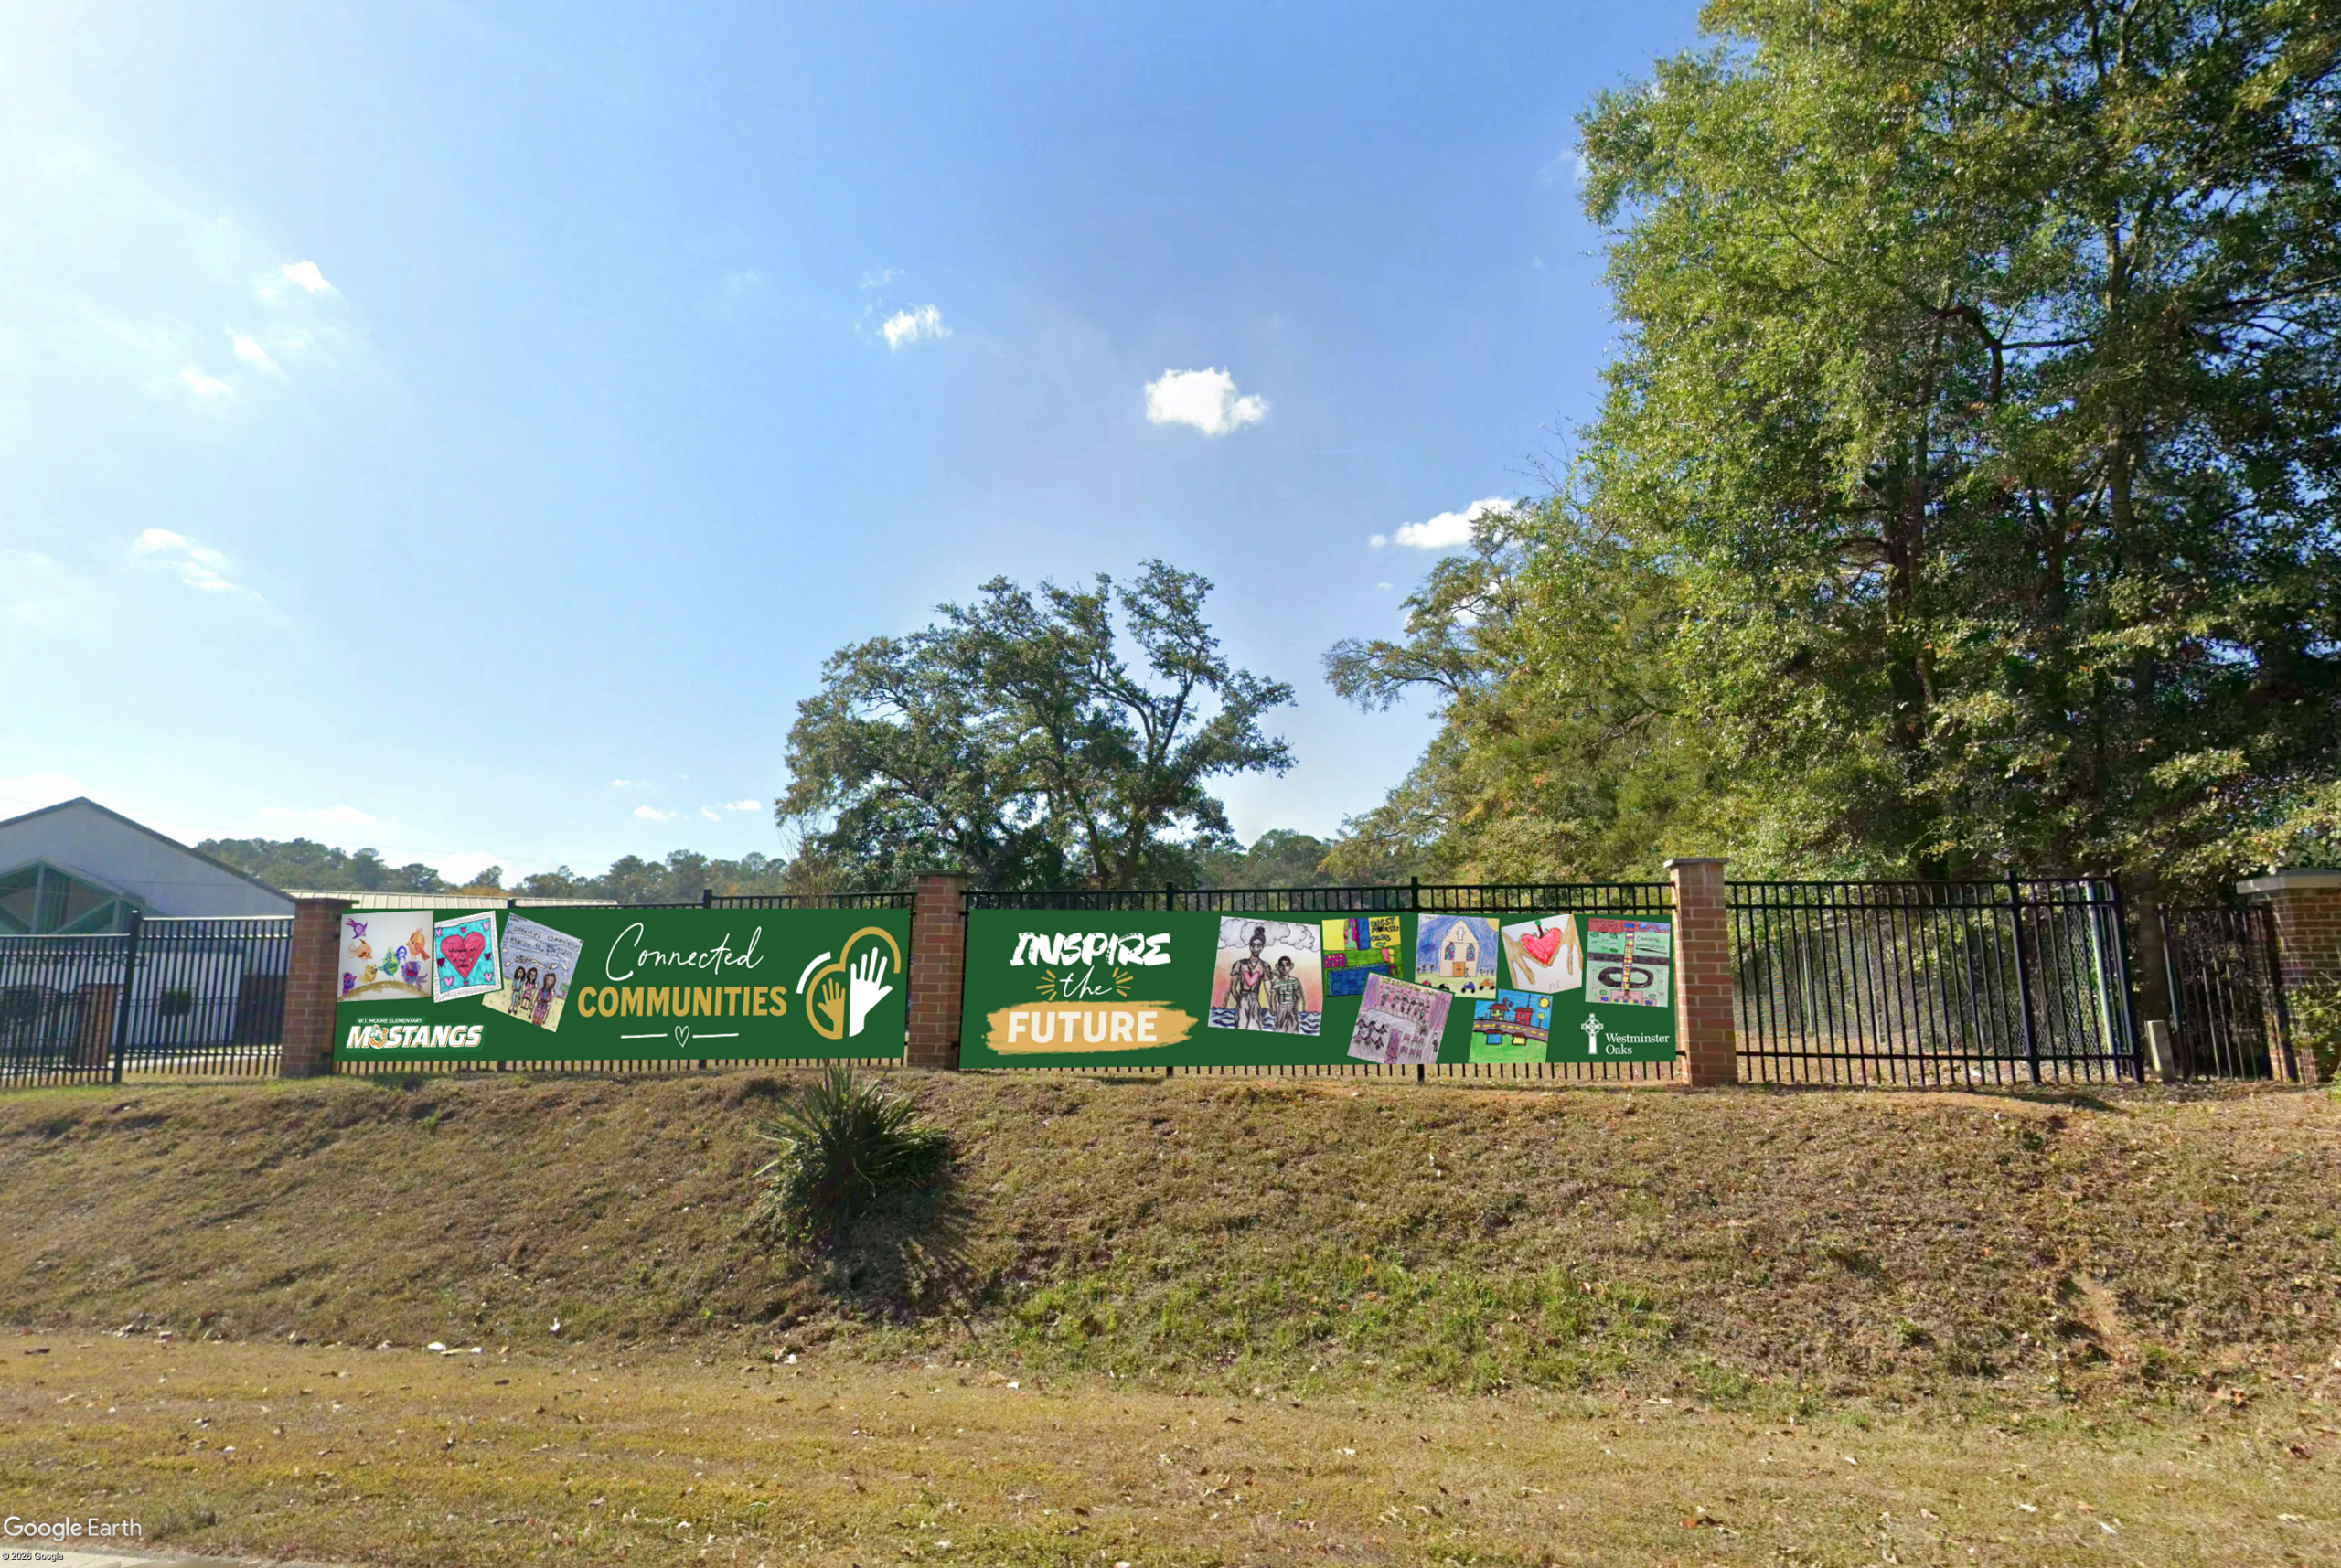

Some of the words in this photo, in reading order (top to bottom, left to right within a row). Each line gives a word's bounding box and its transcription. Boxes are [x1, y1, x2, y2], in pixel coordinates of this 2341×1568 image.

[605, 922, 764, 982] Connected
[1010, 932, 1171, 966] INSPIRE
[1059, 965, 1113, 999] the
[577, 986, 787, 1018] COMMUNITIES
[1007, 1011, 1159, 1044] FUTURE
[1605, 1032, 1670, 1043] Westminster
[1605, 1043, 1633, 1055] Oaks
